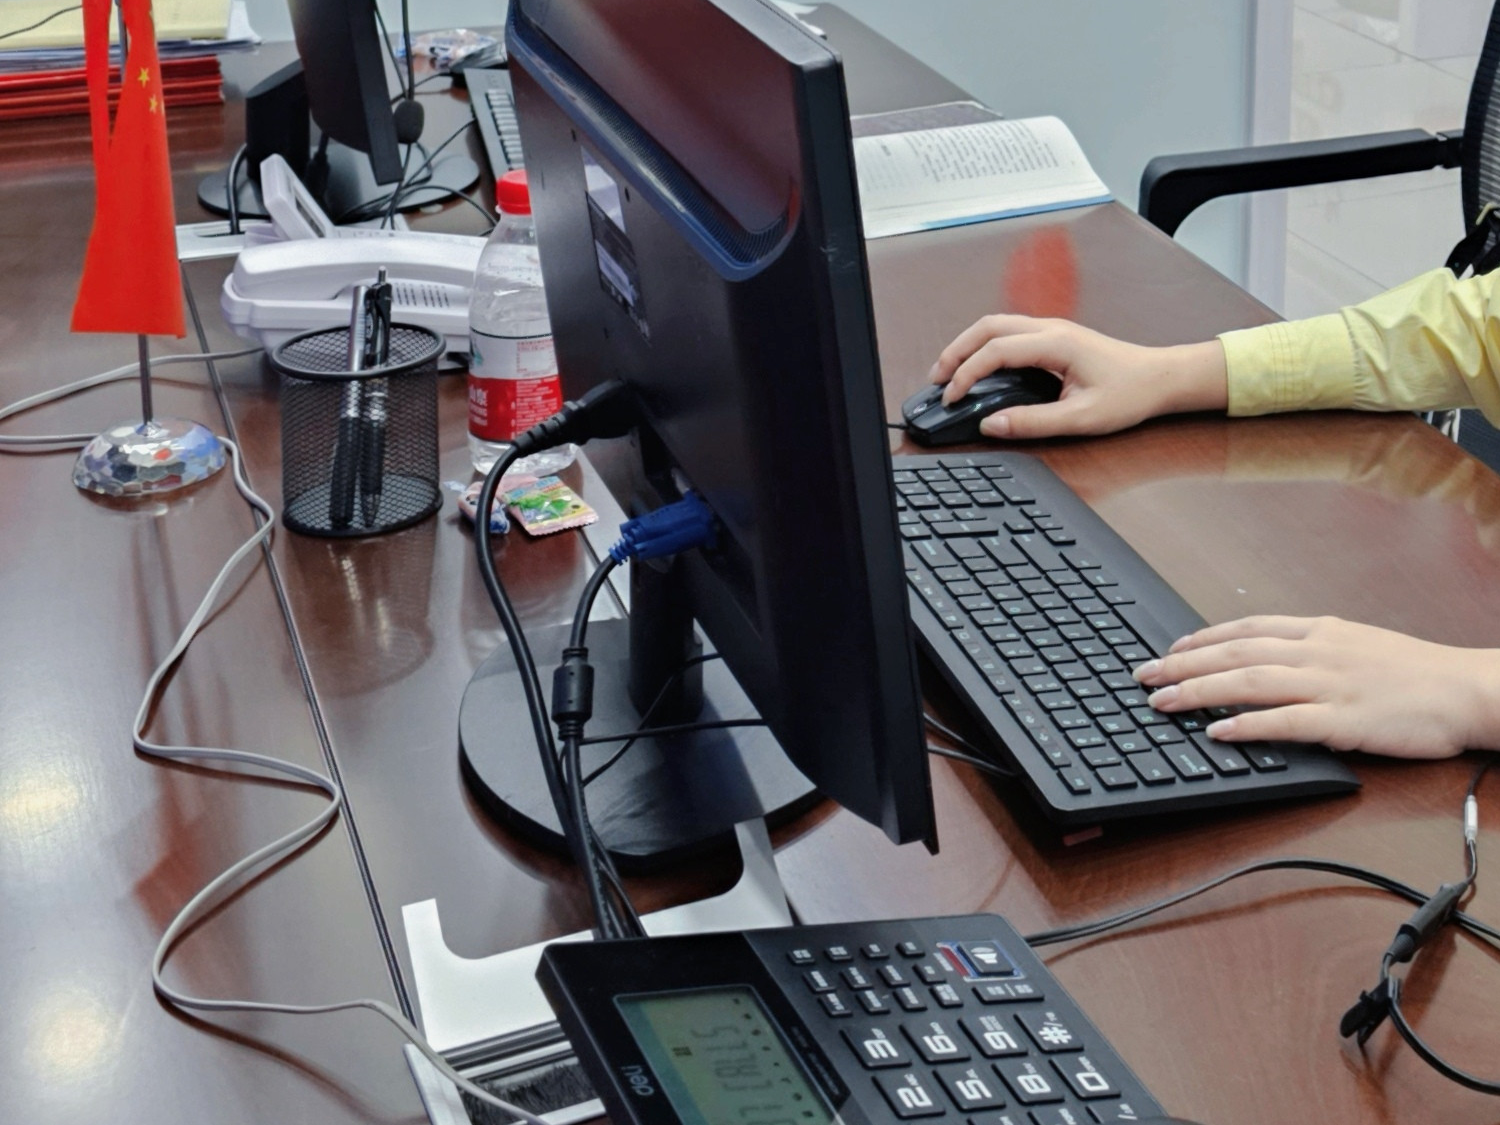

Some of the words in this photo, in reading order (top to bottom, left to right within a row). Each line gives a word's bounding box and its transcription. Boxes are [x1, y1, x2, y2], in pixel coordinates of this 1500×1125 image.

[863, 1038, 899, 1059] 3
[922, 1034, 958, 1055] 6
[983, 1030, 1019, 1050] 9
[620, 1064, 655, 1096] deli
[955, 1078, 993, 1101] 5
[1016, 1073, 1052, 1095] 8
[896, 1085, 933, 1108] 2
